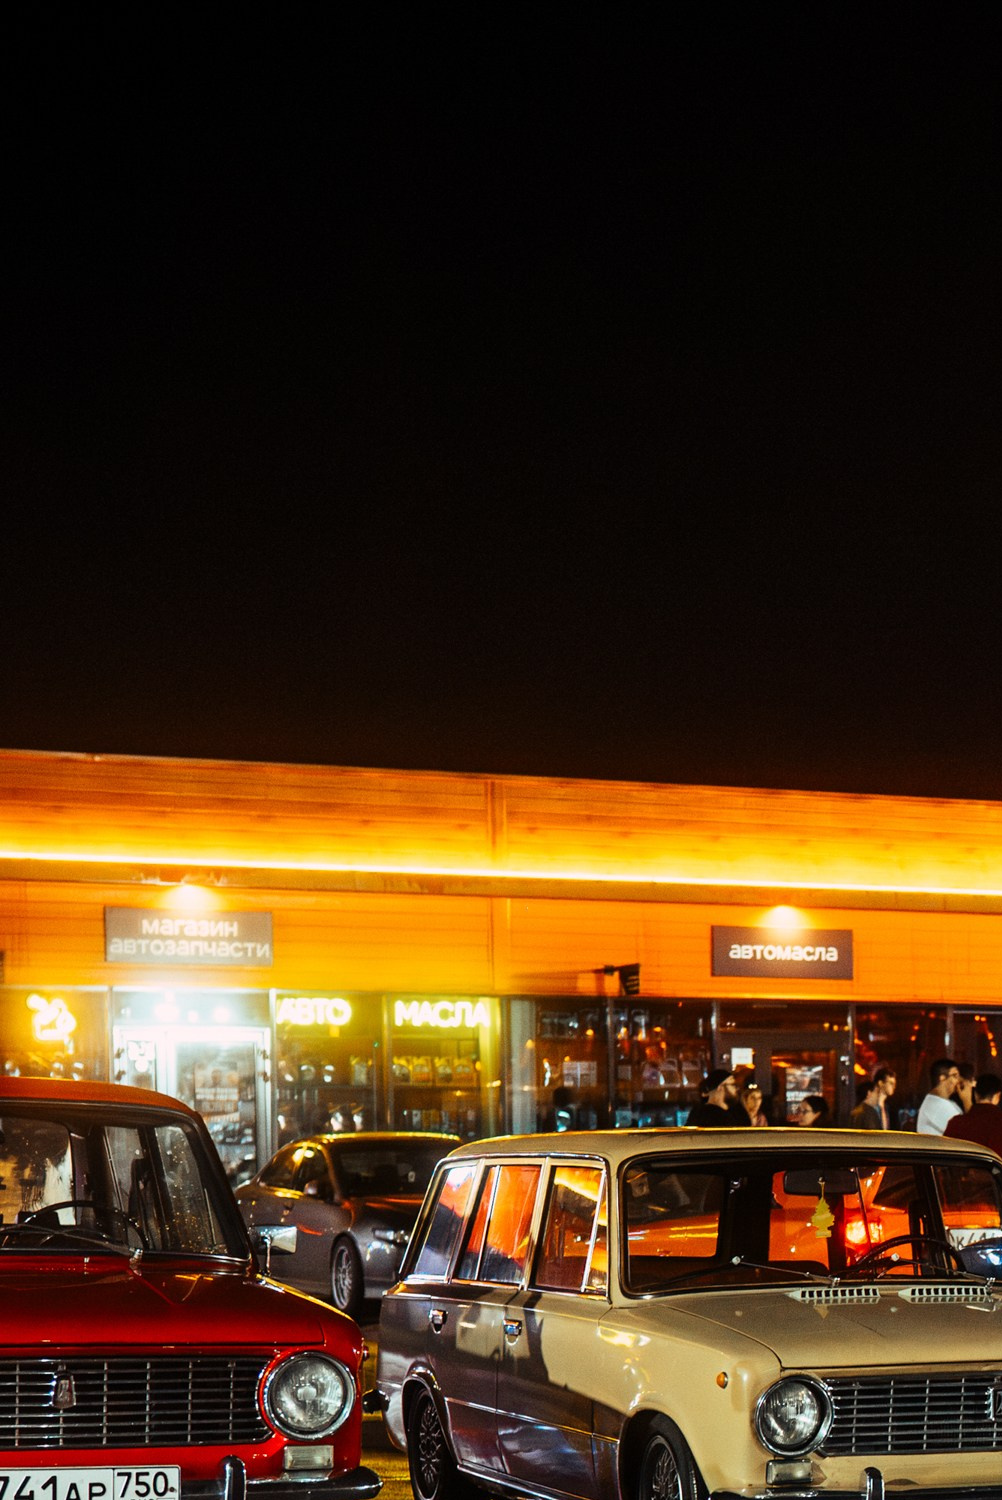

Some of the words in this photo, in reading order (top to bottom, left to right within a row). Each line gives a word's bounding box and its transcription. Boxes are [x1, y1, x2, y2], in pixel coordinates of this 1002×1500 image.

[141, 918, 239, 938] магазин
[109, 937, 271, 958] автозапчасти
[728, 944, 839, 962] автомасла
[276, 998, 353, 1026] АВТО
[394, 1000, 491, 1028] МАСЛА
[116, 1471, 169, 1498] 750
